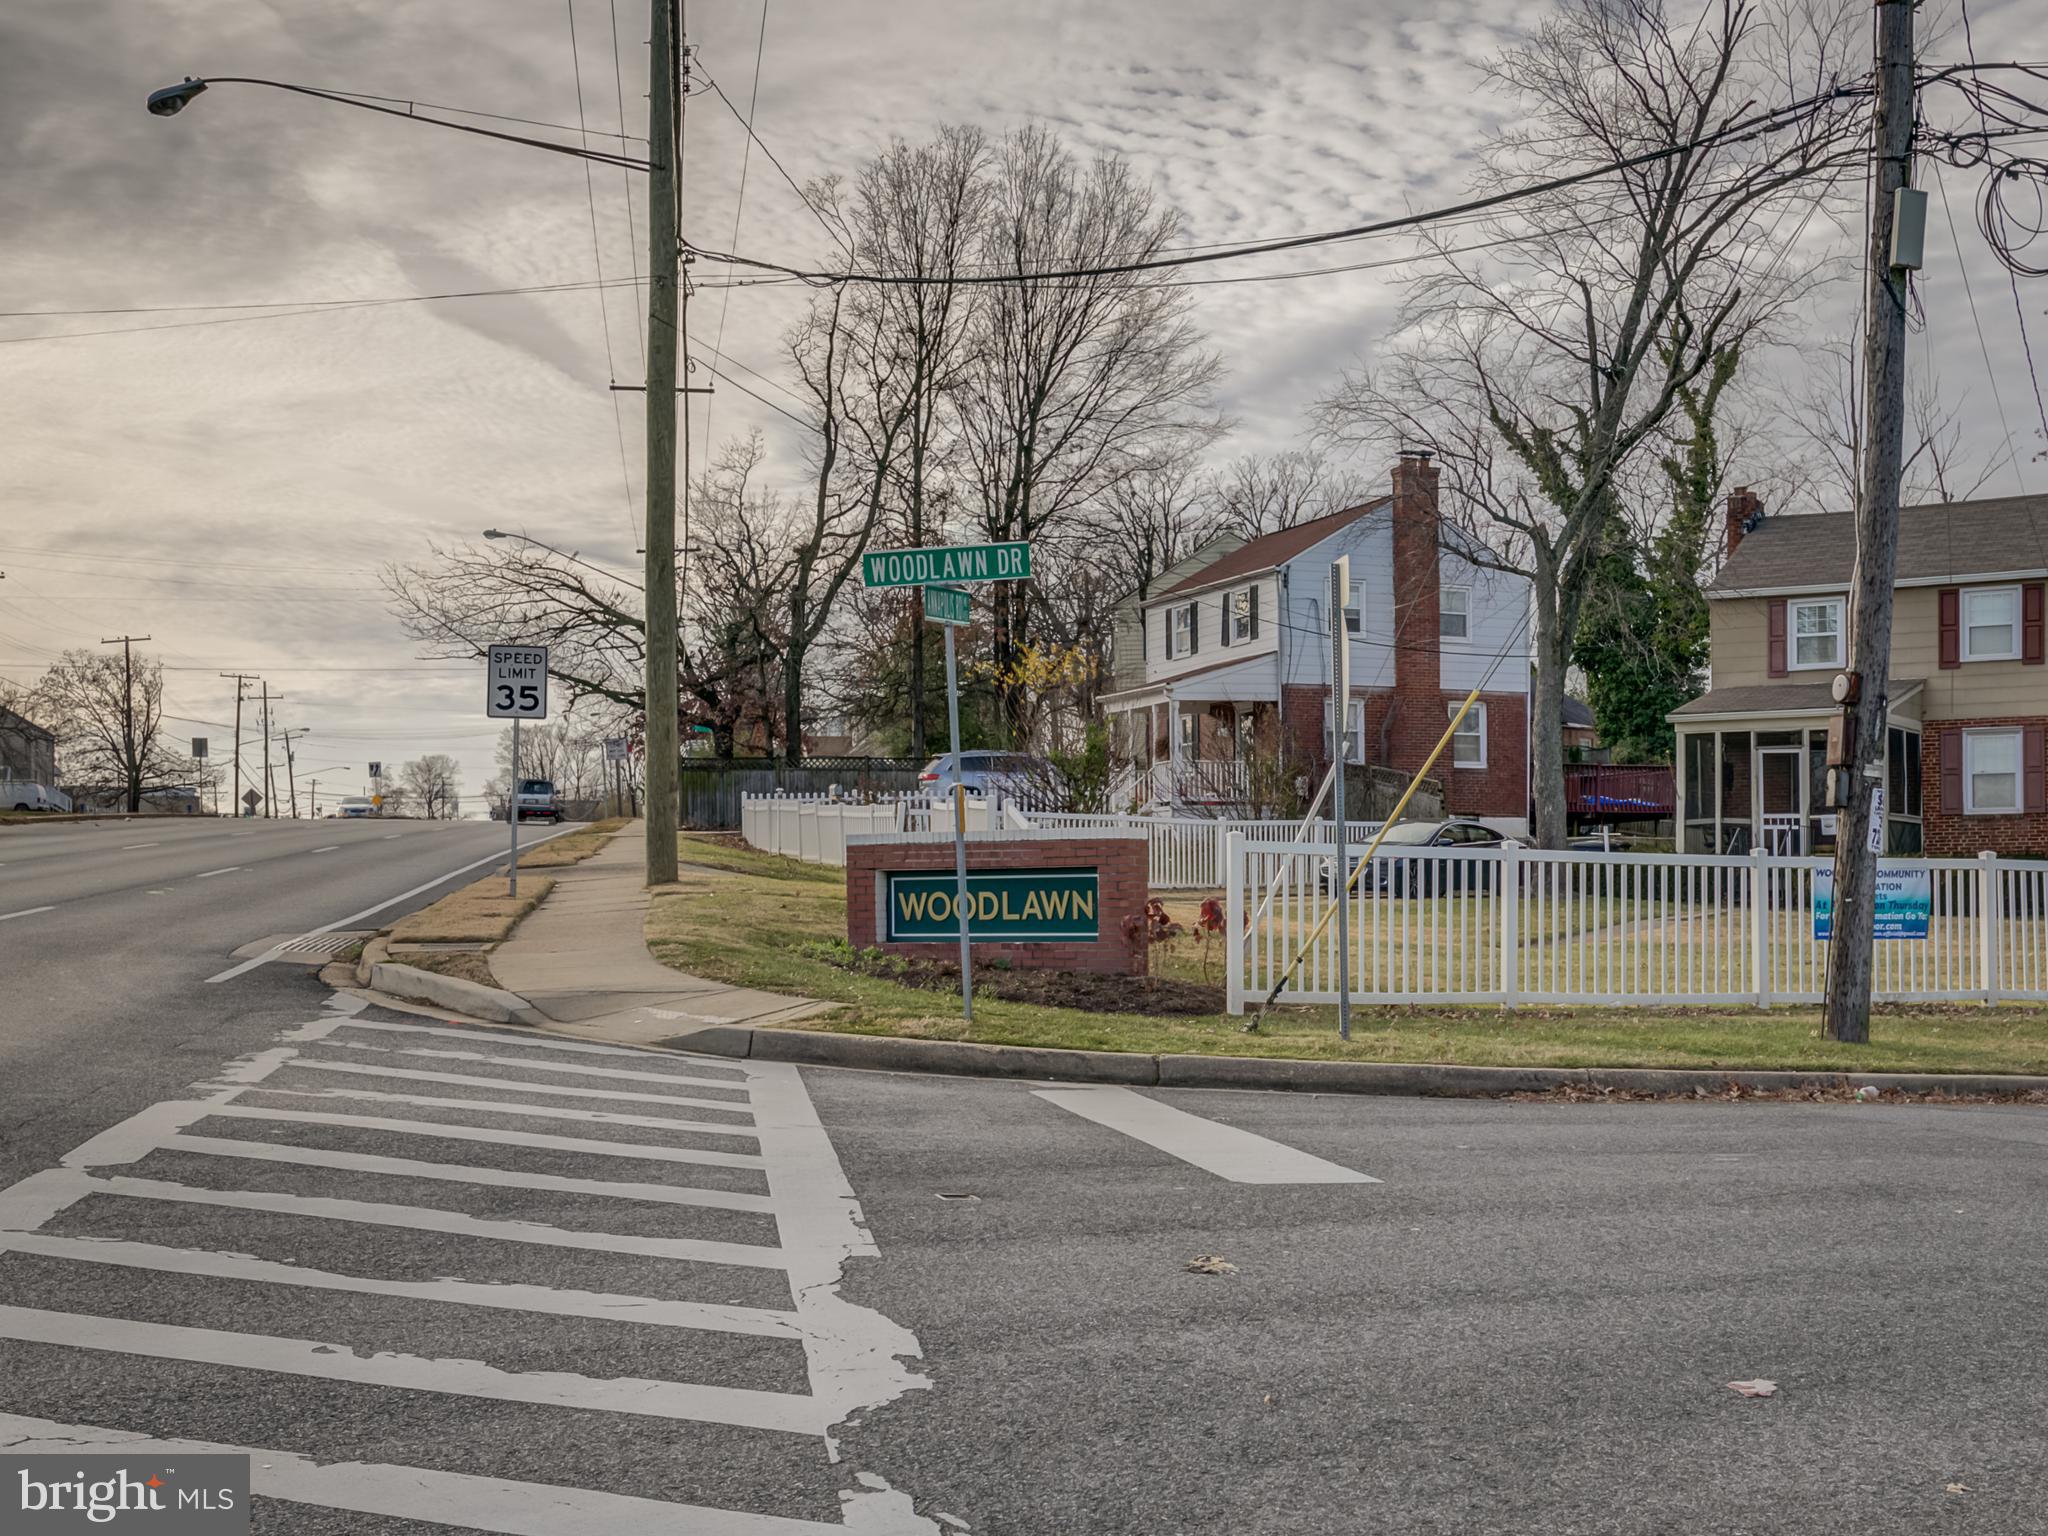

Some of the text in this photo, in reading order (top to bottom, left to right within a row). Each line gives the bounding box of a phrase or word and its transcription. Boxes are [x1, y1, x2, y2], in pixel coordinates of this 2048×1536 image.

[870, 548, 1023, 583] WOODLAWN DR
[494, 652, 542, 665] SPEED
[498, 667, 537, 679] LIMIT
[495, 685, 540, 711] 35
[1876, 870, 1926, 878] OMMUNITY
[1875, 882, 1902, 890] ATION
[898, 890, 1094, 921] WOODLAWN
[1888, 901, 1928, 912] Thursday
